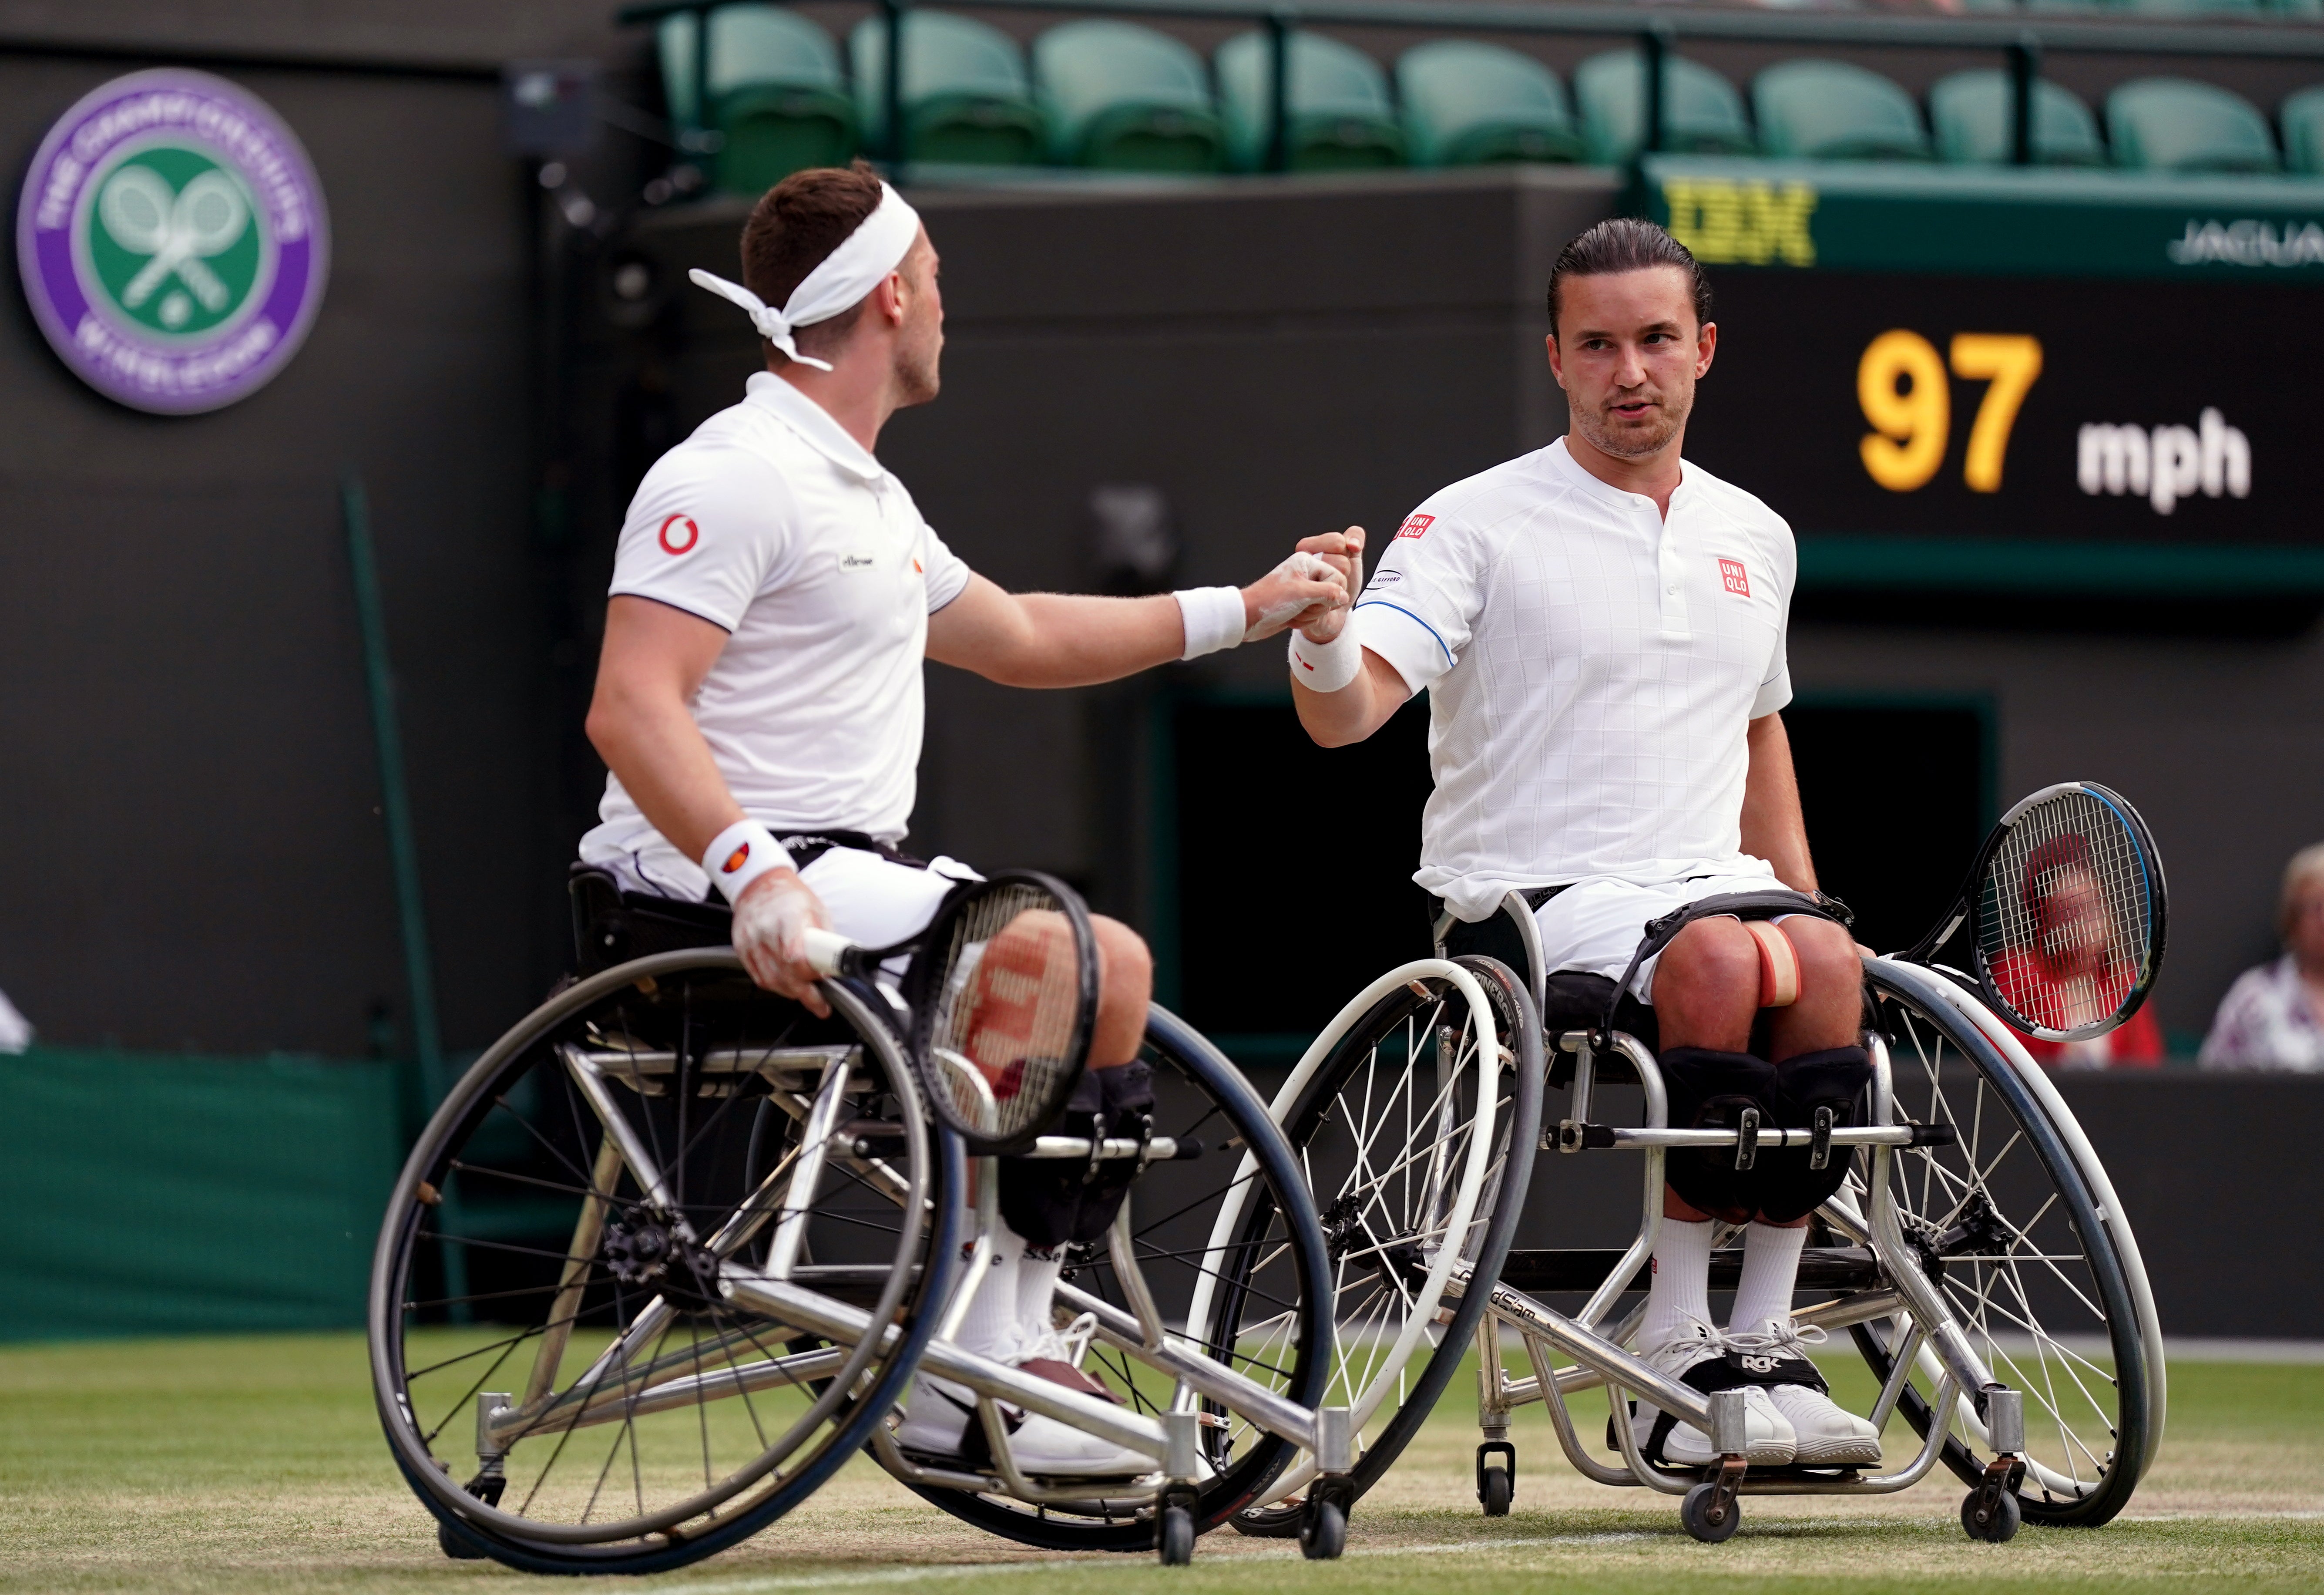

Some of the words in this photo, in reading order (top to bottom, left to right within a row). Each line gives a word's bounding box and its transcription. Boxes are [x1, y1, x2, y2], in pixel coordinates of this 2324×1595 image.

[1663, 178, 1819, 267] IBM
[1856, 328, 2044, 494] 97
[2077, 407, 2251, 515] mph
[1412, 517, 1430, 527] UNI
[1404, 527, 1424, 536] QLO
[1721, 562, 1743, 579] UNI
[1726, 576, 1747, 593] QLO
